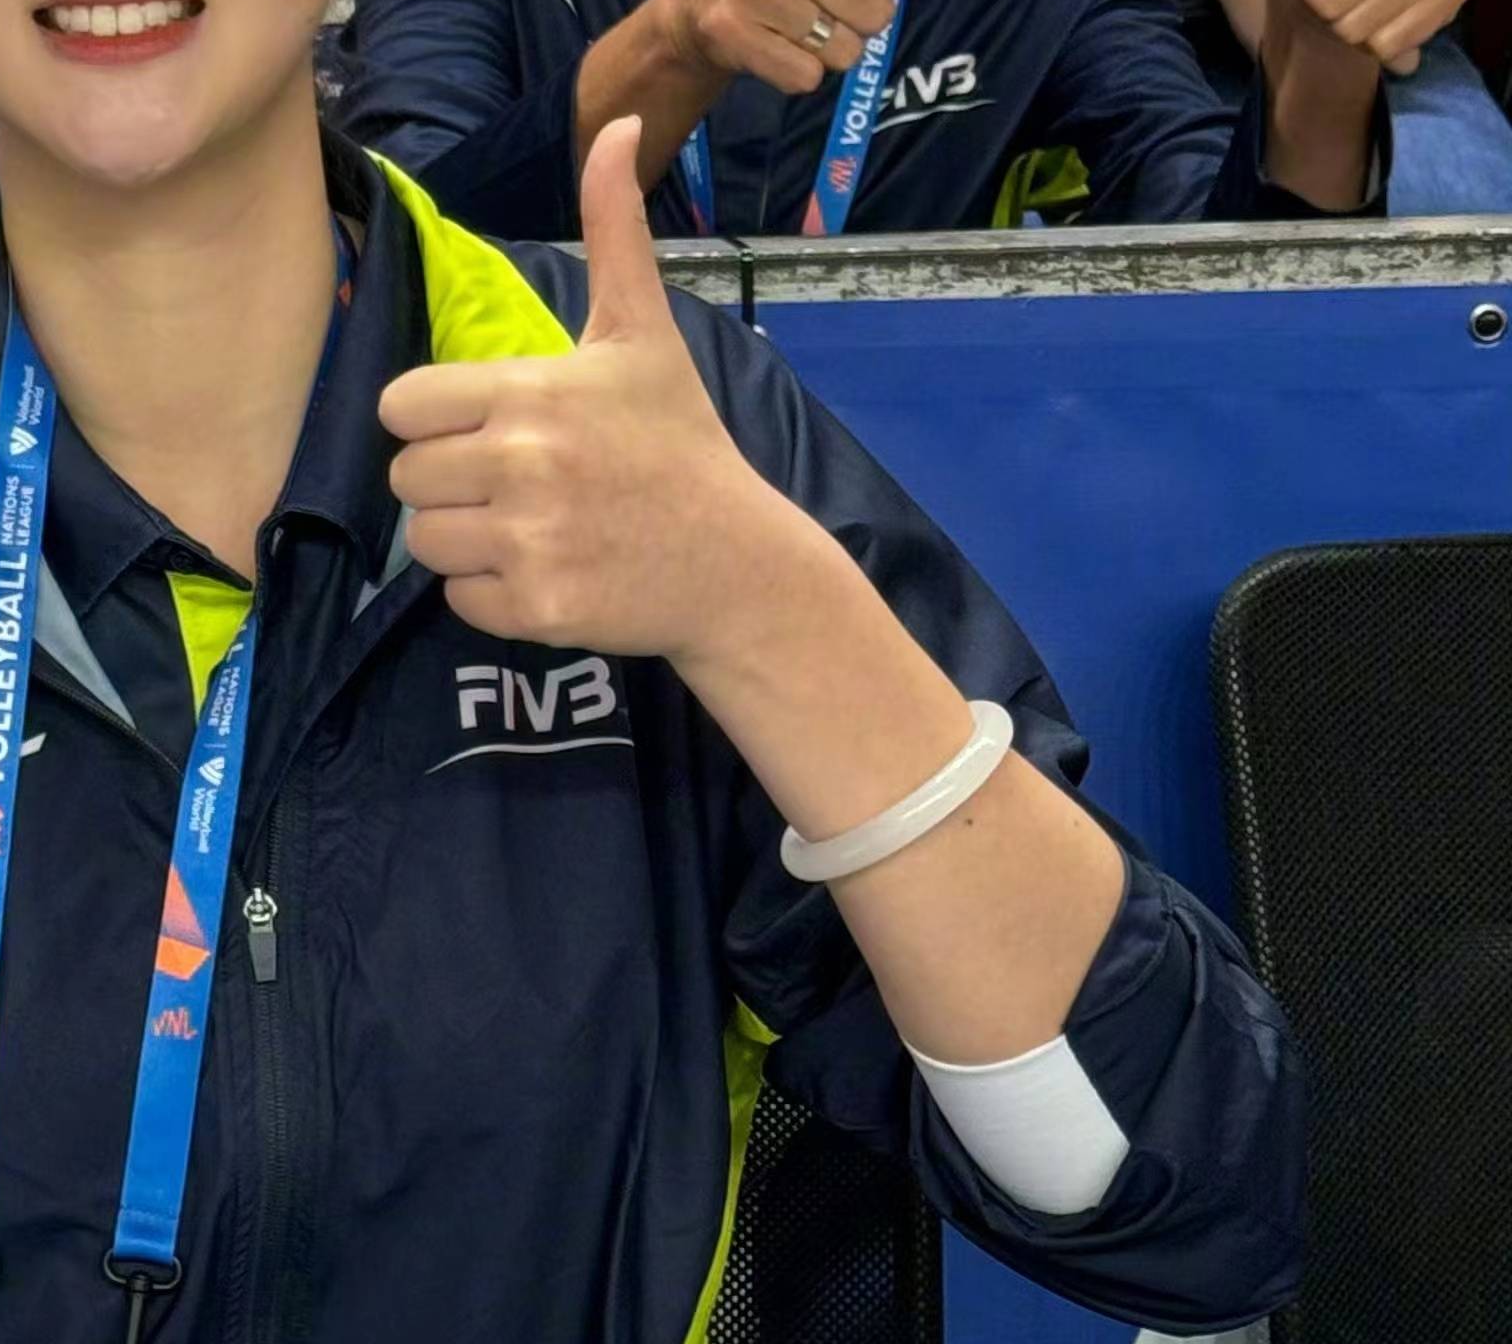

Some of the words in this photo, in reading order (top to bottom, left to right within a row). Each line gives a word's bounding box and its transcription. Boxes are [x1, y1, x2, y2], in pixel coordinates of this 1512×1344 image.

[839, 22, 893, 147] VOLLEYBA
[1, 474, 20, 545] NATIONS
[19, 485, 35, 546] LEAGUE
[217, 665, 241, 737] NATIONS
[455, 656, 617, 733] FIVB
